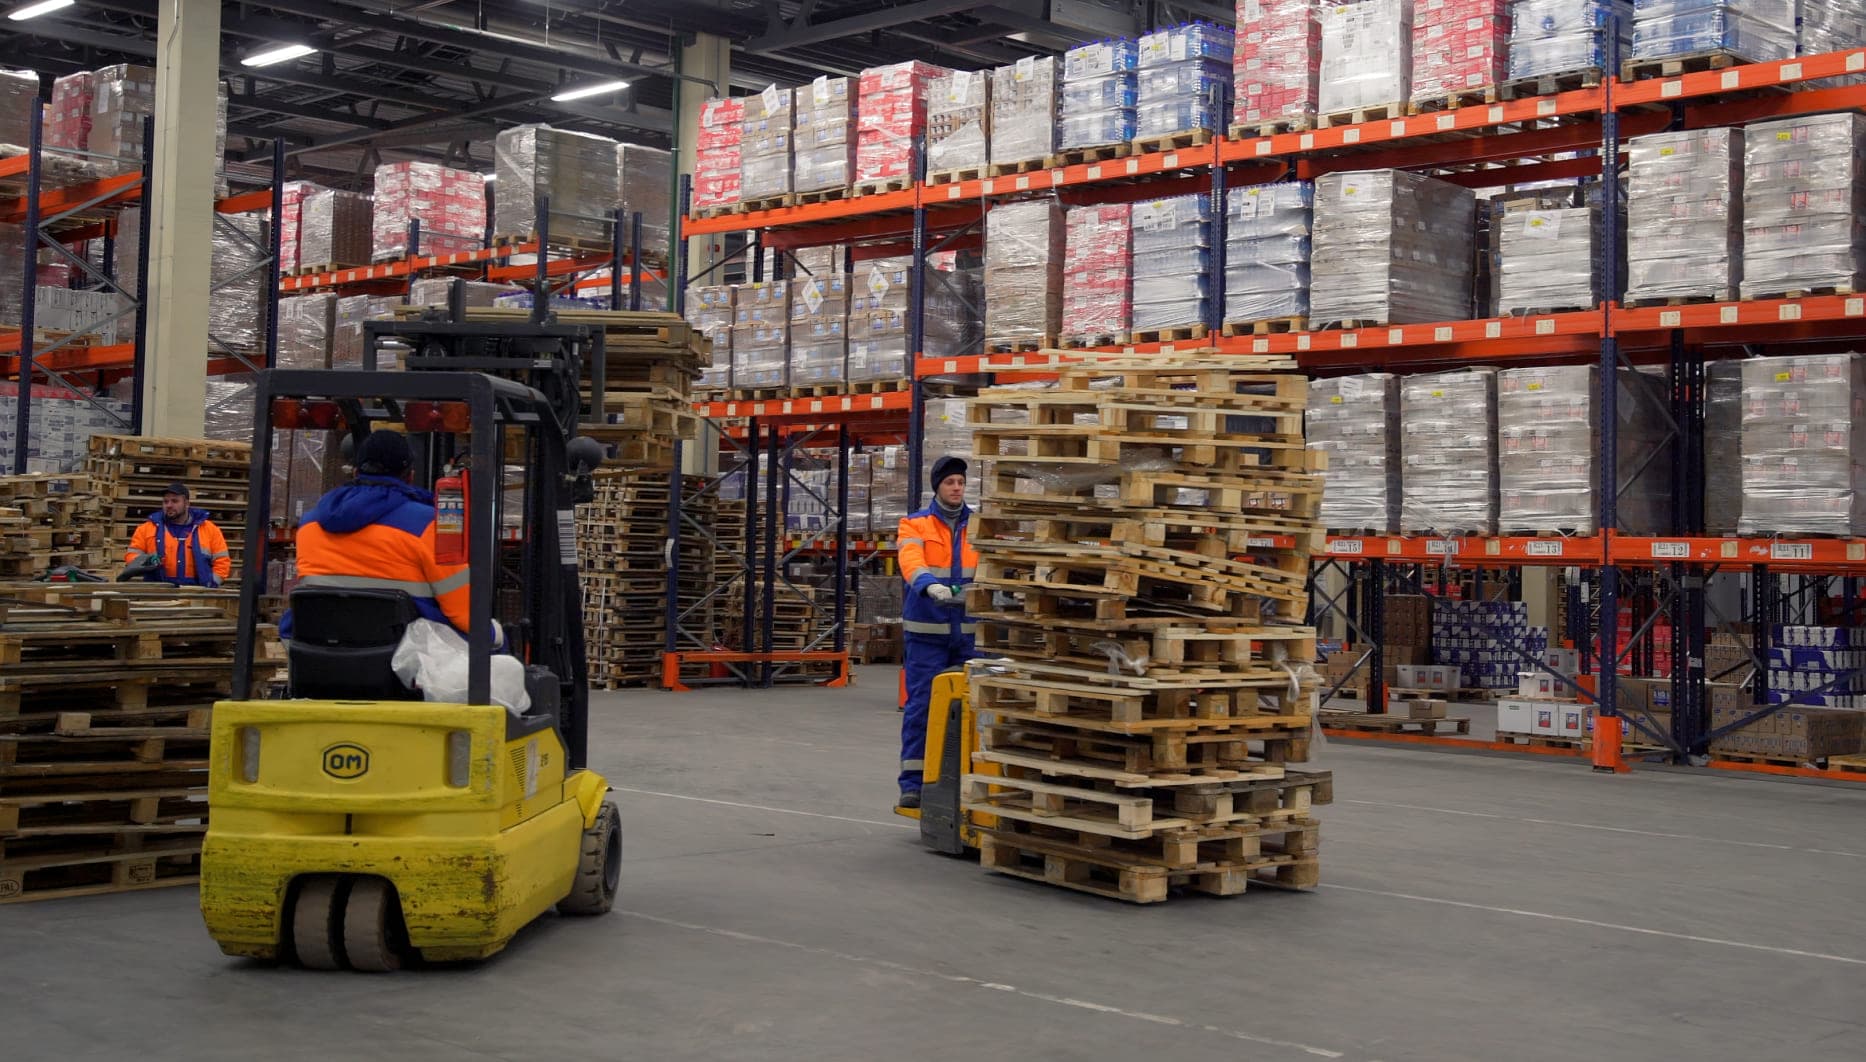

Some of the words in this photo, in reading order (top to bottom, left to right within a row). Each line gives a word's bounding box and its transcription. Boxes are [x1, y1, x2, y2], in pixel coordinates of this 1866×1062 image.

[1546, 544, 1557, 554] 13
[1672, 546, 1684, 556] 12
[1793, 547, 1804, 558] 11
[330, 754, 362, 770] OM
